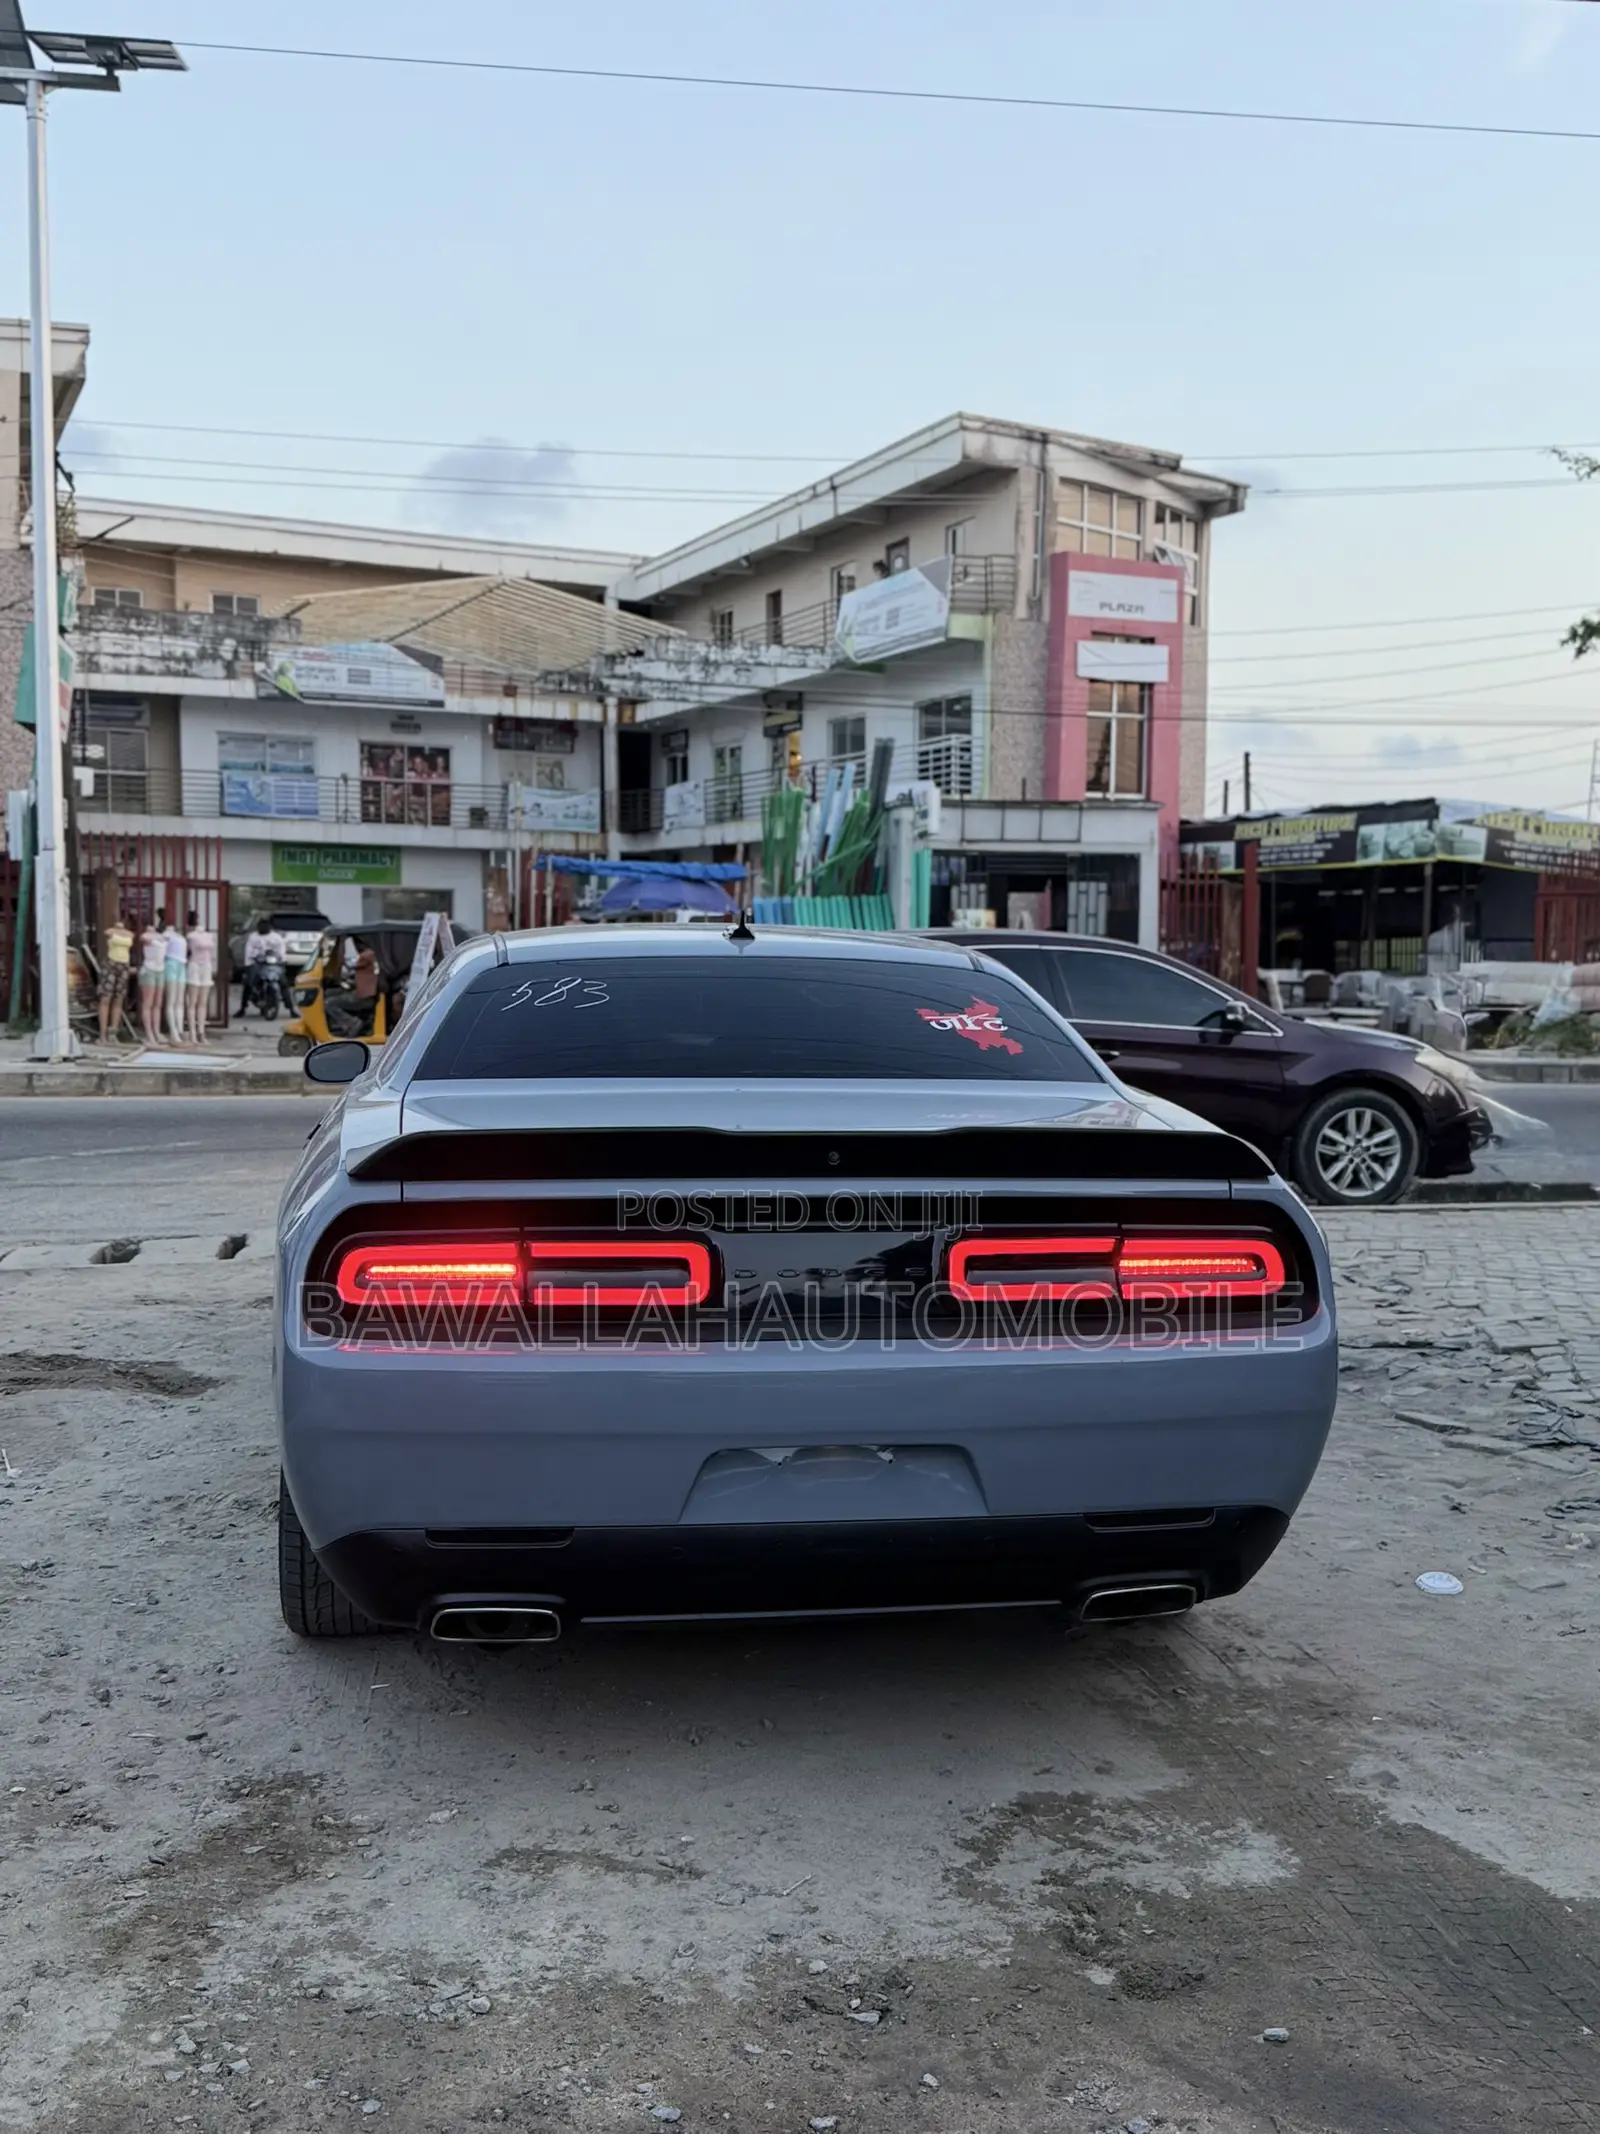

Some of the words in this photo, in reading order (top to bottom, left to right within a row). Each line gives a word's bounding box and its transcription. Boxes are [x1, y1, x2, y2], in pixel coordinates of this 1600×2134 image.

[1099, 601, 1145, 614] PLAZA
[320, 849, 397, 868] PHARMACY
[500, 976, 610, 1011] 583
[732, 1266, 927, 1280] DODGE
